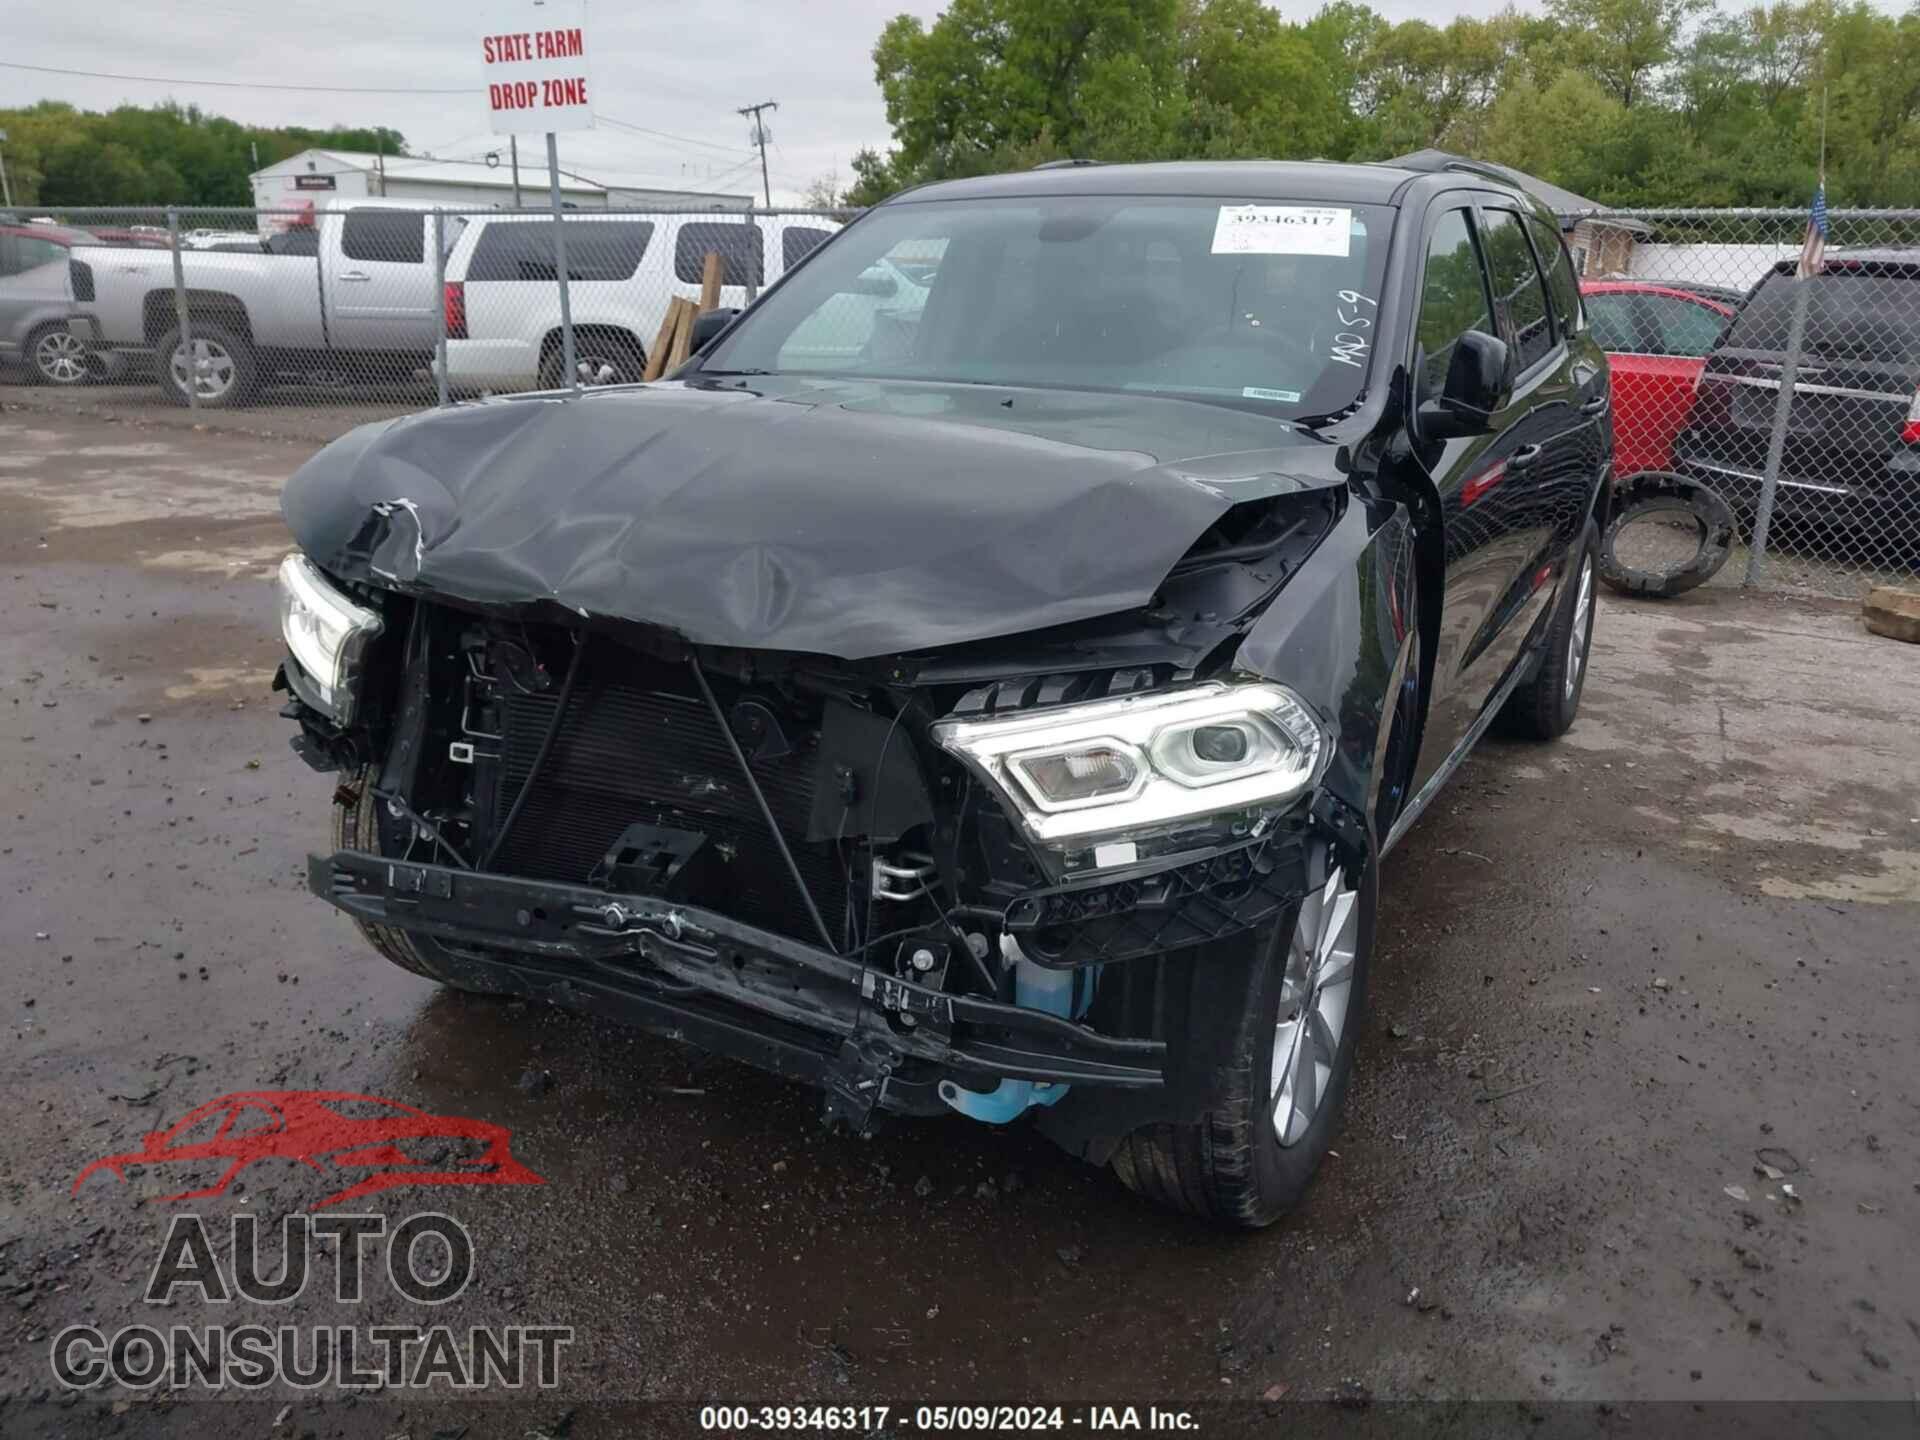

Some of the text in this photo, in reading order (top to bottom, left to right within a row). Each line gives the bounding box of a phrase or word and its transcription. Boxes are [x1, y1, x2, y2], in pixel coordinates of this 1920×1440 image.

[483, 28, 583, 64] STATE FARM
[489, 77, 588, 111] DROP ZONE
[1231, 214, 1336, 226] 39346317
